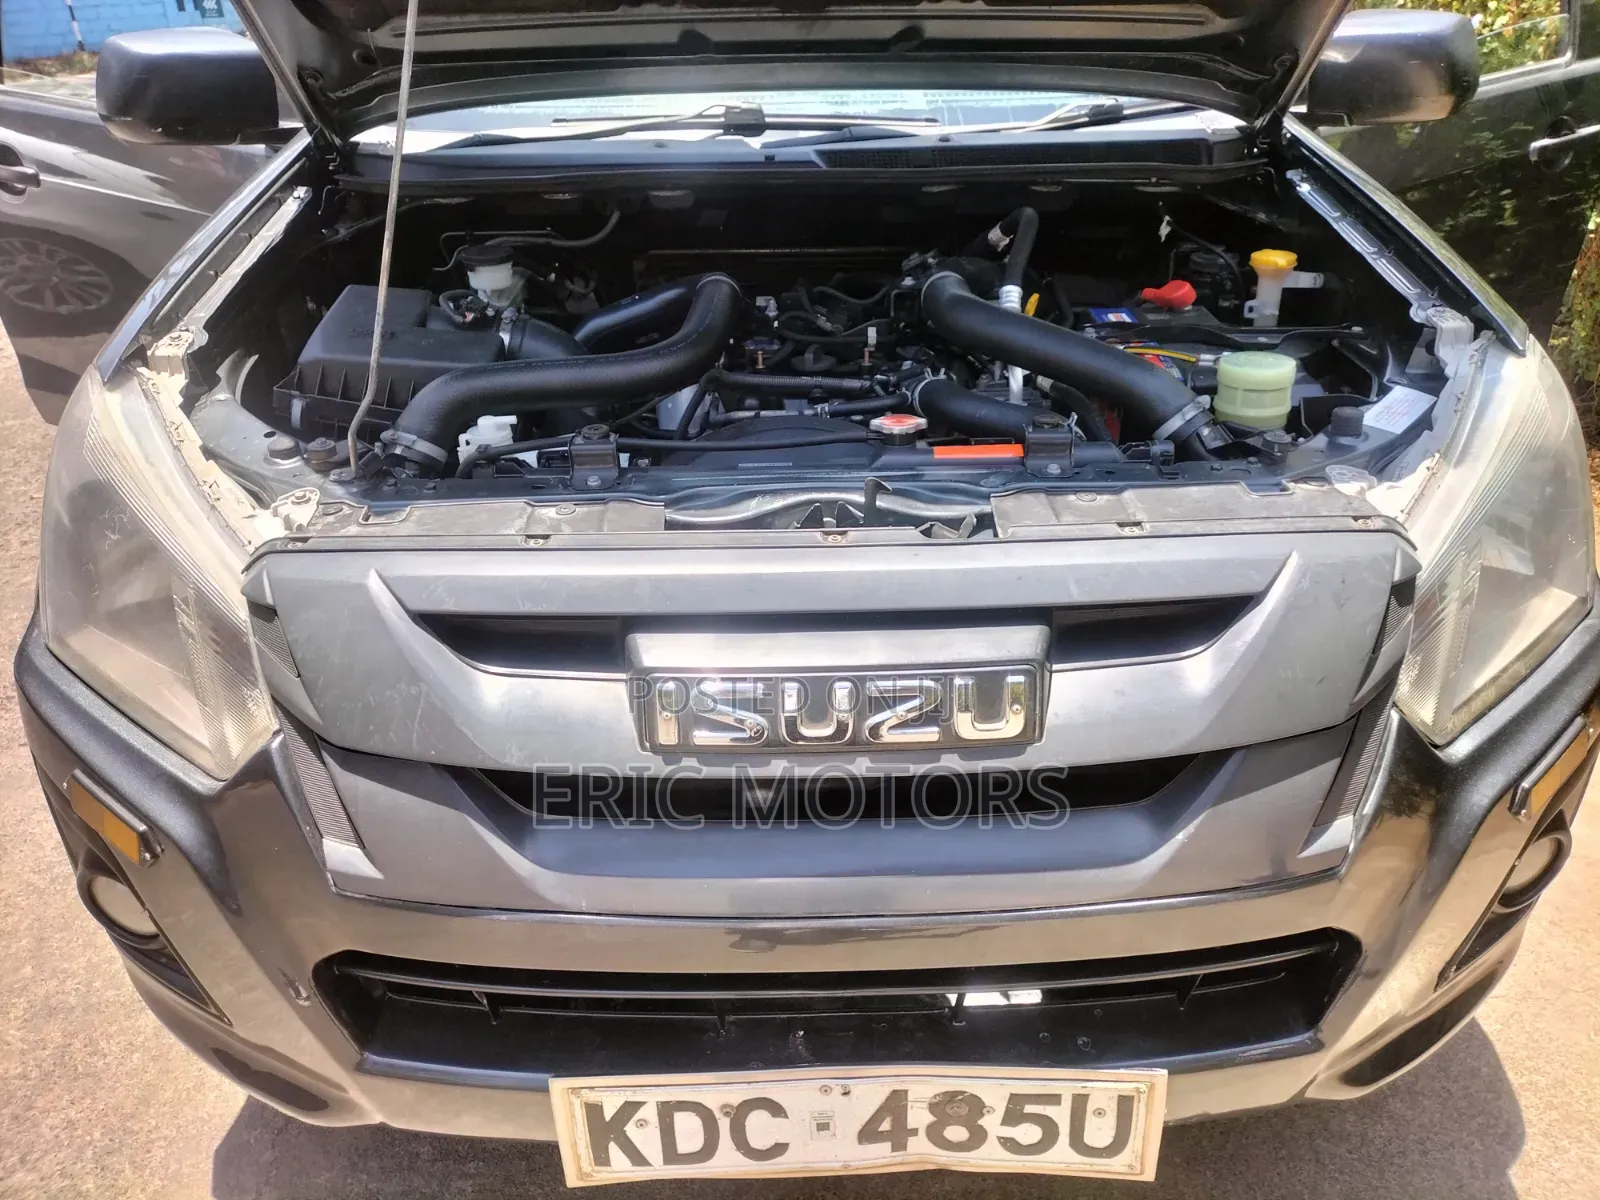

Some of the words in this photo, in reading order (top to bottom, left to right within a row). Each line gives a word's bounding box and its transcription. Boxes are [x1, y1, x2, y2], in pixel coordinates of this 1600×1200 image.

[656, 675, 1027, 745] ISUZU
[584, 1096, 790, 1168] KDC
[857, 1088, 1132, 1158] 485U
